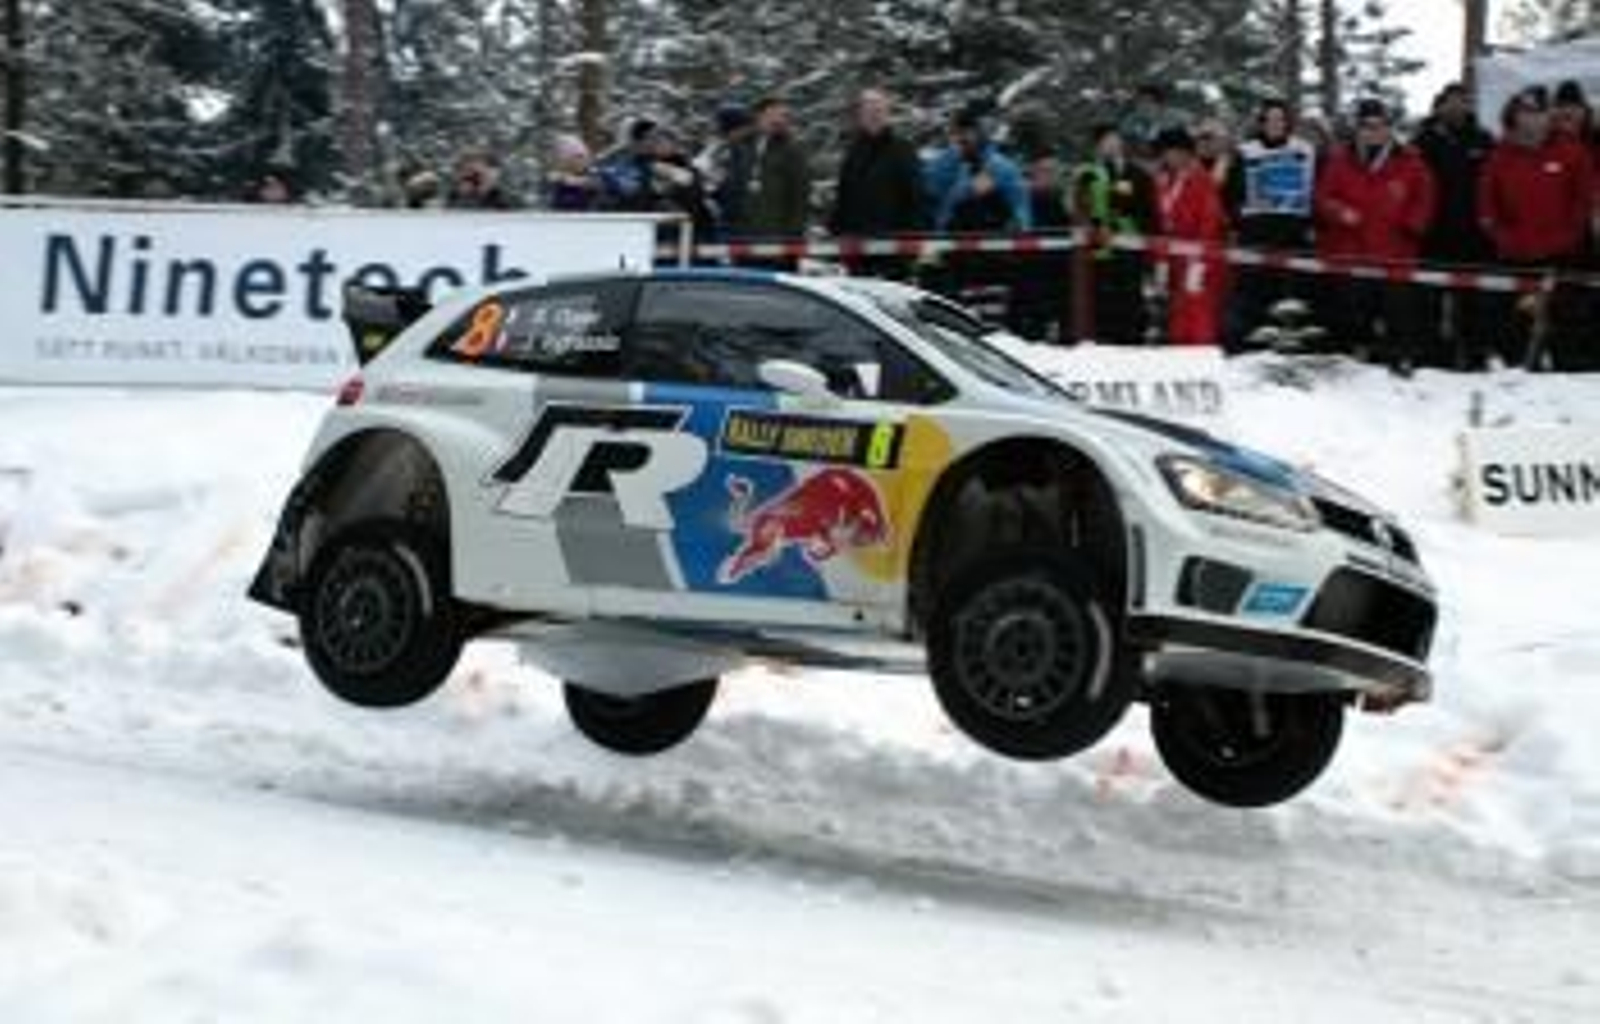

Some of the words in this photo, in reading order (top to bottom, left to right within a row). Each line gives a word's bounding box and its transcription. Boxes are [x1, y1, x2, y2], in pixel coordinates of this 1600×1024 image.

[451, 301, 502, 356] 8
[1062, 380, 1222, 415] RMLAND
[482, 402, 708, 531] R
